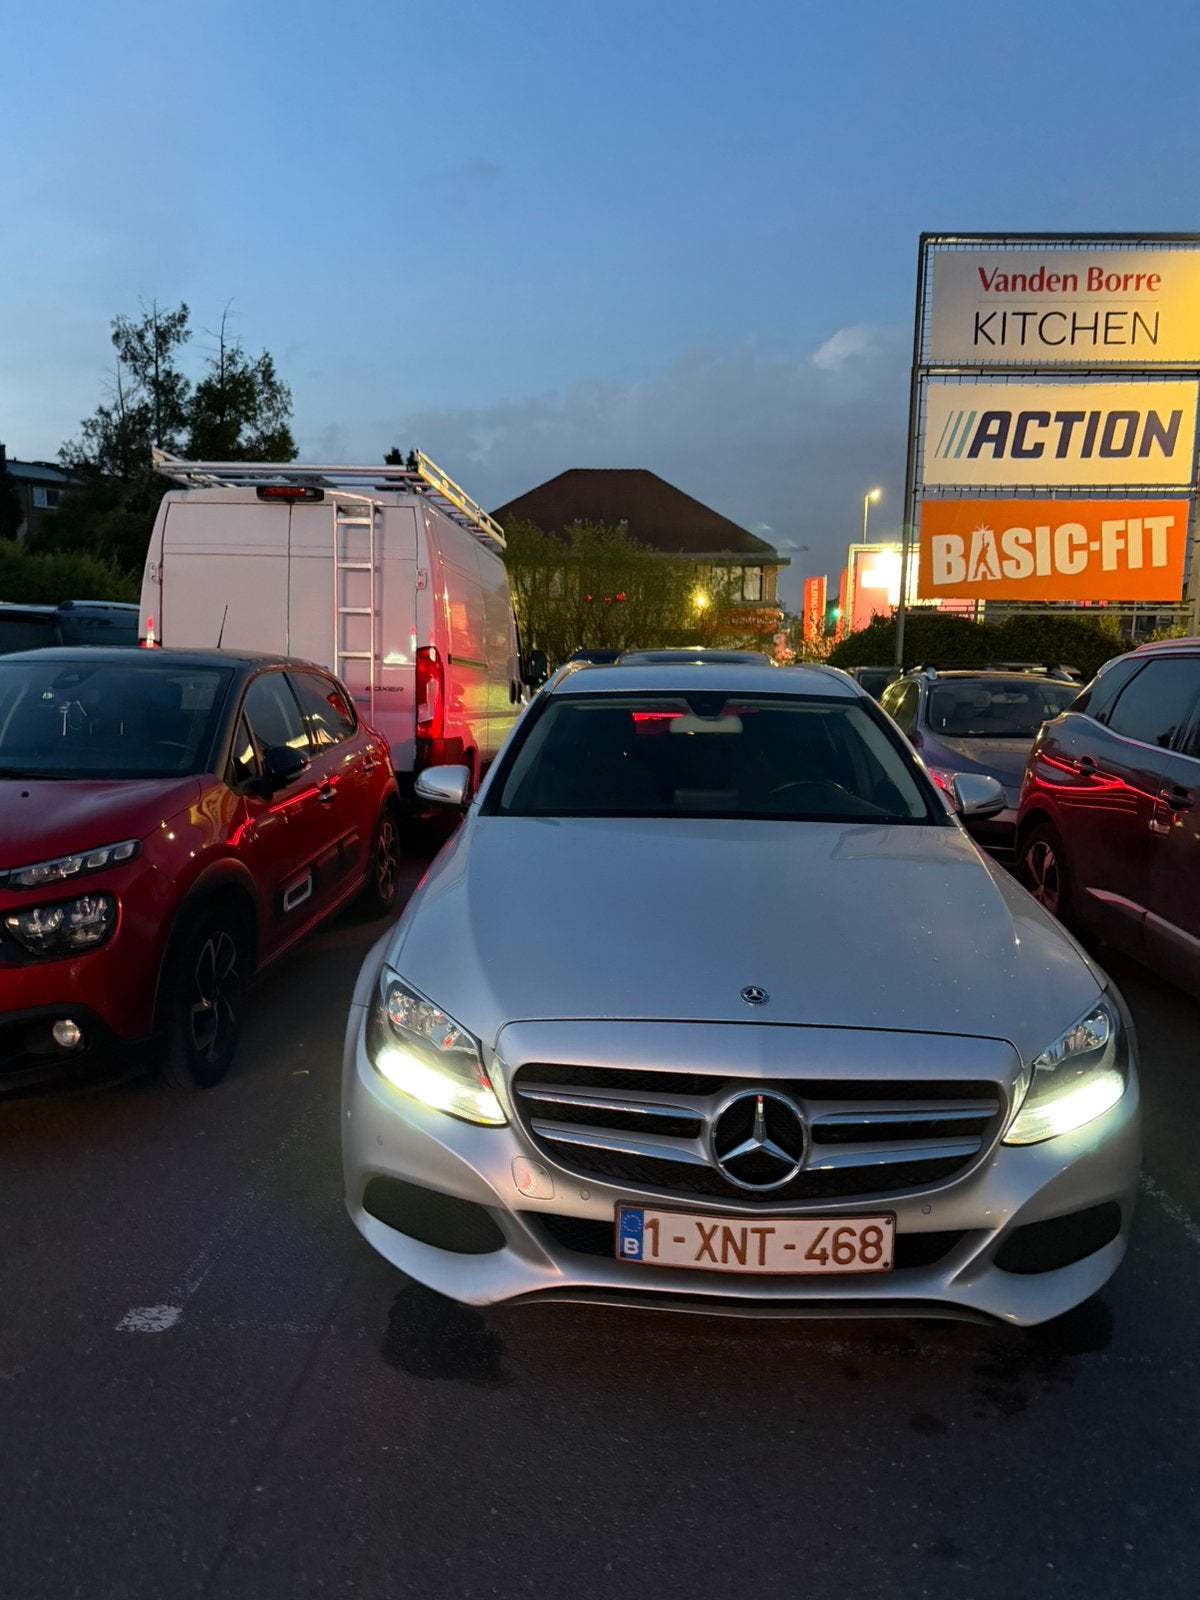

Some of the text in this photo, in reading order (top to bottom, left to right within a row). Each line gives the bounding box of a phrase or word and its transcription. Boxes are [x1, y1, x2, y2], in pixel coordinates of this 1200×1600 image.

[977, 266, 1162, 293] Vanden Borre
[973, 311, 1160, 346] KITCHEN
[966, 409, 1183, 459] ACTION
[931, 515, 1175, 586] BASIC-FIT
[623, 1237, 639, 1255] B
